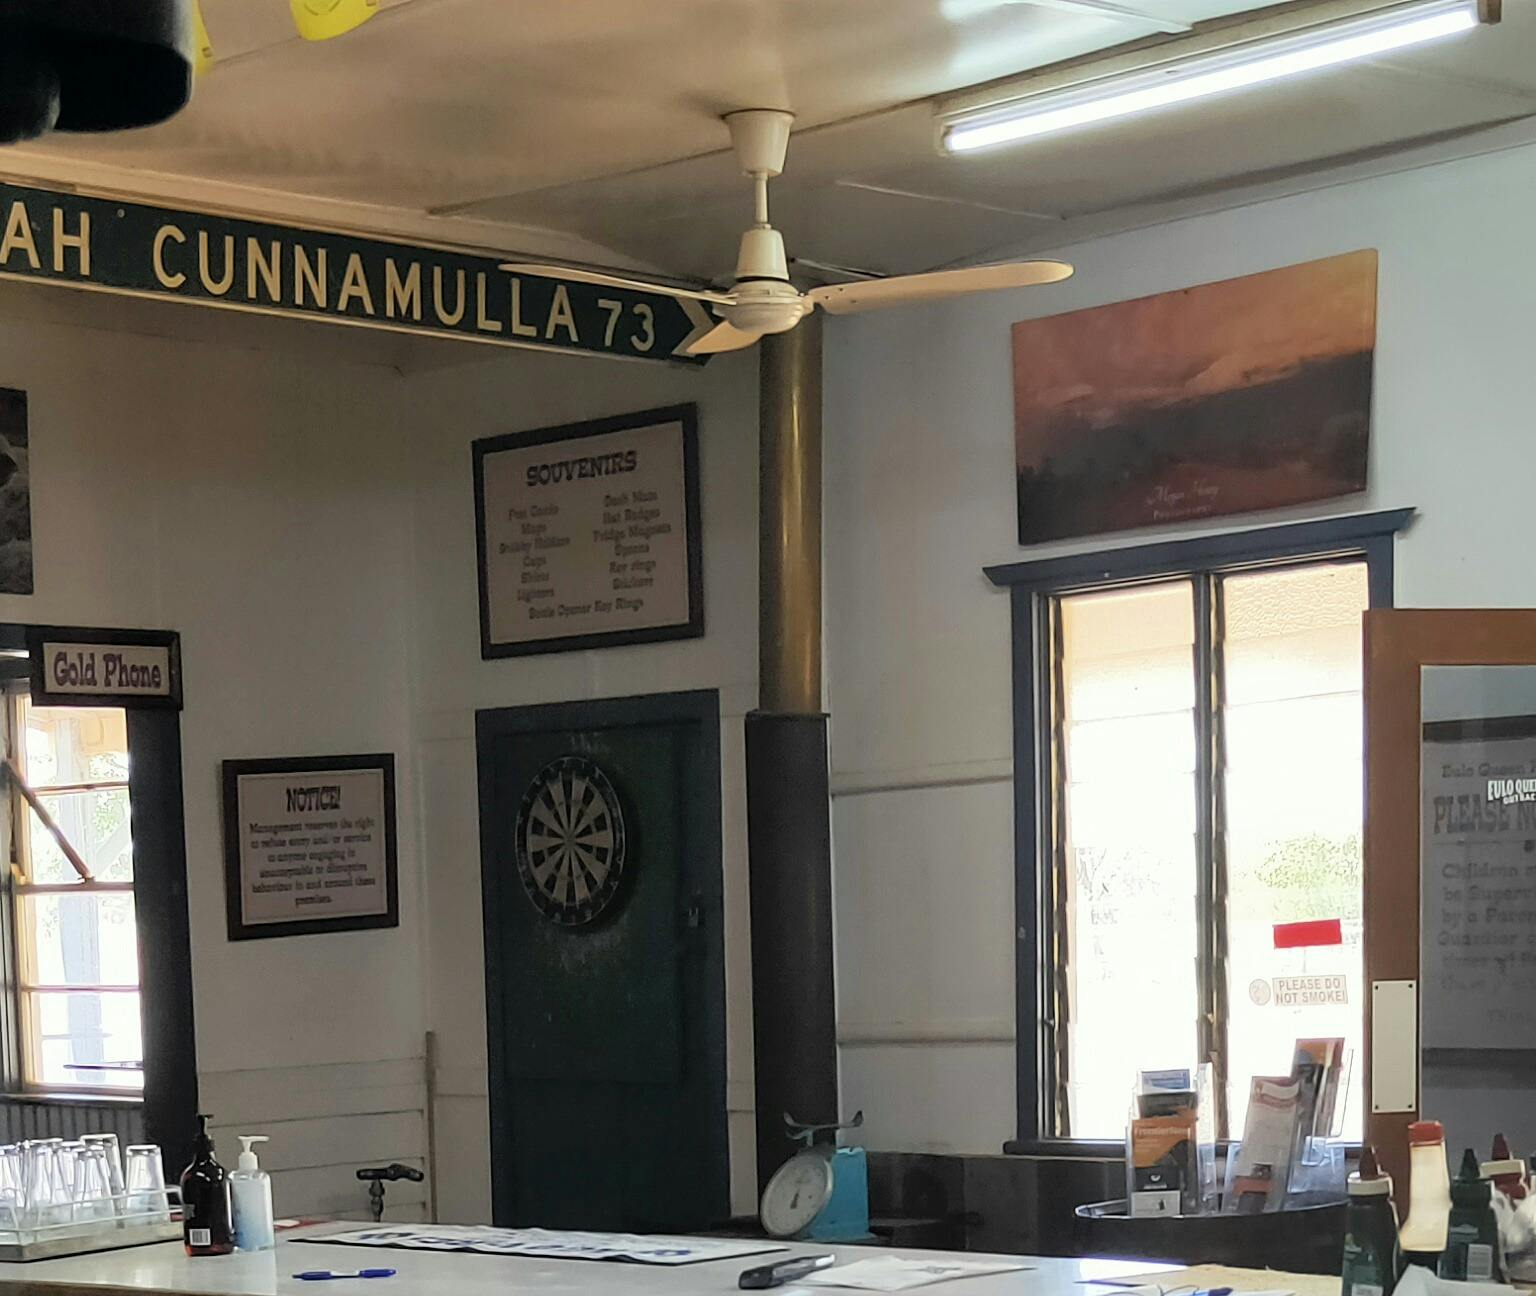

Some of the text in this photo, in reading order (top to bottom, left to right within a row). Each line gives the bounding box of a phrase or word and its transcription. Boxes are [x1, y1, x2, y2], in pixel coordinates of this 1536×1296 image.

[152, 222, 580, 344] CUNNAMULLA
[597, 296, 658, 353] 73
[526, 450, 637, 486] SOUVENIRS
[53, 651, 162, 689] Gold Phone
[286, 786, 341, 813] NOTICE!
[1487, 779, 1514, 801] EULO
[1433, 794, 1510, 834] PLEASE
[1276, 990, 1345, 1005] NOT SMOKE!
[1278, 978, 1341, 991] PLEASE DO
